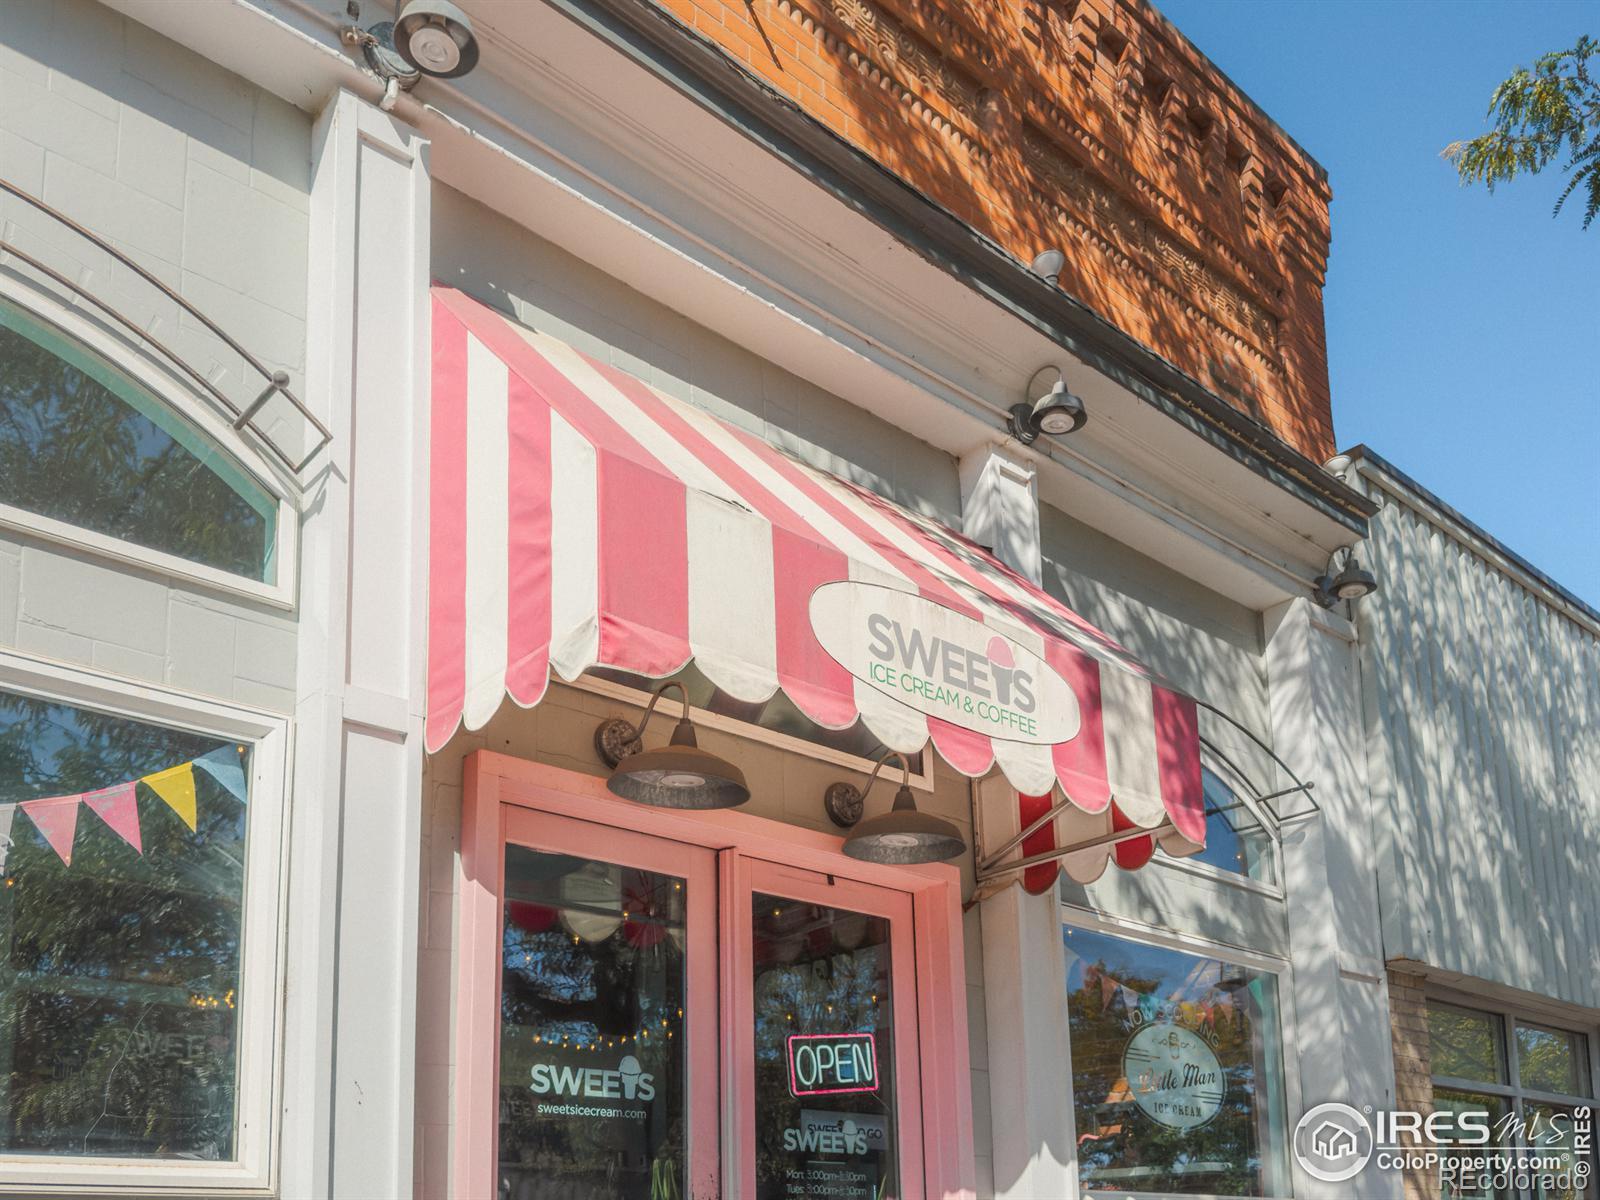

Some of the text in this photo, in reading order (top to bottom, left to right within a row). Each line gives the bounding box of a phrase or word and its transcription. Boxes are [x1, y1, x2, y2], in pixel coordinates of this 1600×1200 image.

[867, 613, 1036, 713] SWEETS
[869, 661, 1038, 737] ICE CREAM & COFFEE
[1122, 1003, 1153, 1032] NOW
[530, 1055, 656, 1101] SWEETS
[796, 1042, 873, 1086] OPEN
[1183, 1062, 1217, 1088] Man
[537, 1104, 647, 1119] sweetsicecream.com
[1172, 1104, 1202, 1118] CREAM
[783, 1120, 868, 1155] SWEETS
[867, 1128, 883, 1139] GO
